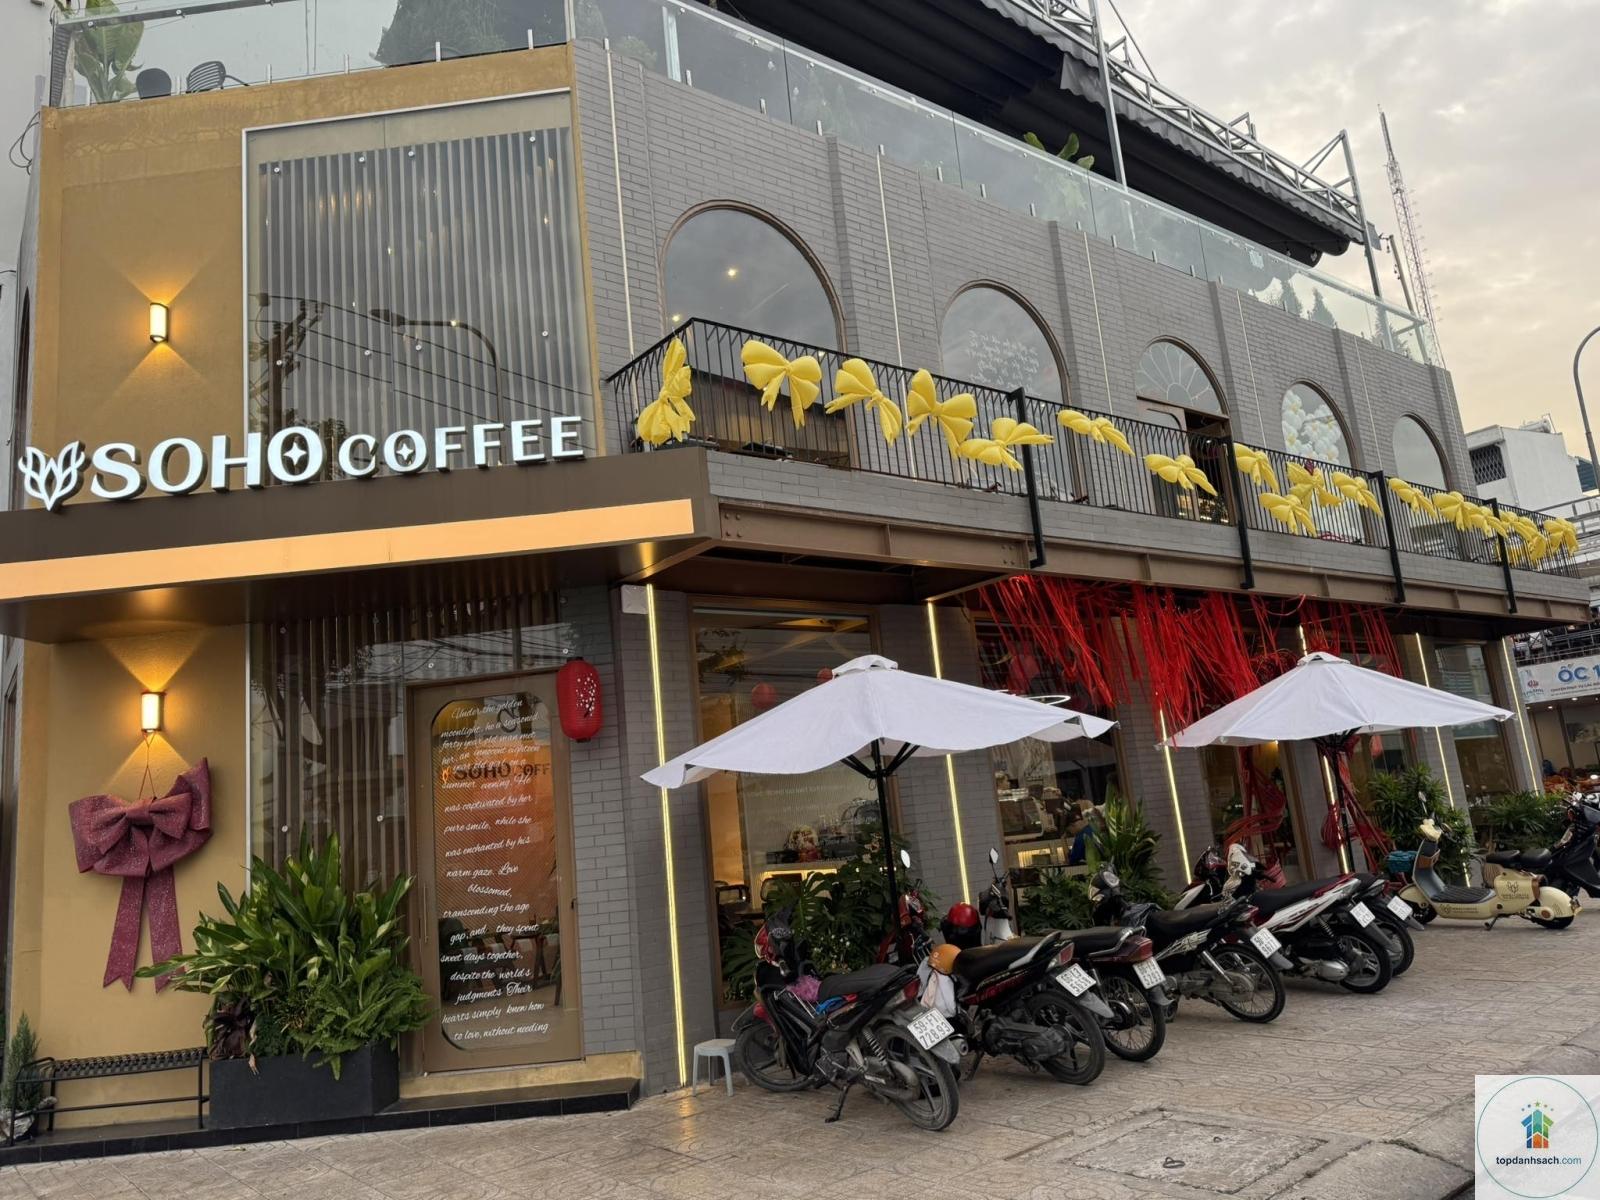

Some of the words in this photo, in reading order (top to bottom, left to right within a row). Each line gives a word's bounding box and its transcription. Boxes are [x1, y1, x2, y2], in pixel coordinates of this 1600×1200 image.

[90, 425, 324, 500] SOHO
[337, 415, 587, 480] COFFEE
[496, 700, 523, 711] golden
[444, 804, 461, 813] was
[462, 797, 507, 812] captivated
[507, 795, 517, 806] by
[518, 794, 532, 802] her
[444, 824, 464, 835] pure
[495, 816, 516, 825] while
[518, 816, 532, 824] she
[445, 848, 461, 857] was
[463, 839, 505, 855] enchanted
[506, 838, 516, 849] by
[517, 835, 530, 846] his
[446, 869, 471, 878] warm
[498, 862, 519, 876] Love
[442, 905, 499, 918] transcending
[500, 902, 514, 912] the
[514, 903, 530, 914] age
[470, 924, 488, 937] and
[496, 923, 514, 935] they
[515, 923, 540, 934] spent
[440, 954, 462, 963] sweet
[464, 952, 485, 964] days
[450, 971, 481, 982] despite
[482, 969, 496, 979] the
[506, 981, 533, 996] Their
[442, 1012, 470, 1024] hearts
[471, 1006, 502, 1018] simply
[506, 1004, 527, 1014] knew
[528, 1001, 545, 1011] how
[454, 1031, 463, 1041] to
[483, 1026, 516, 1038] without
[516, 1022, 549, 1034] needing
